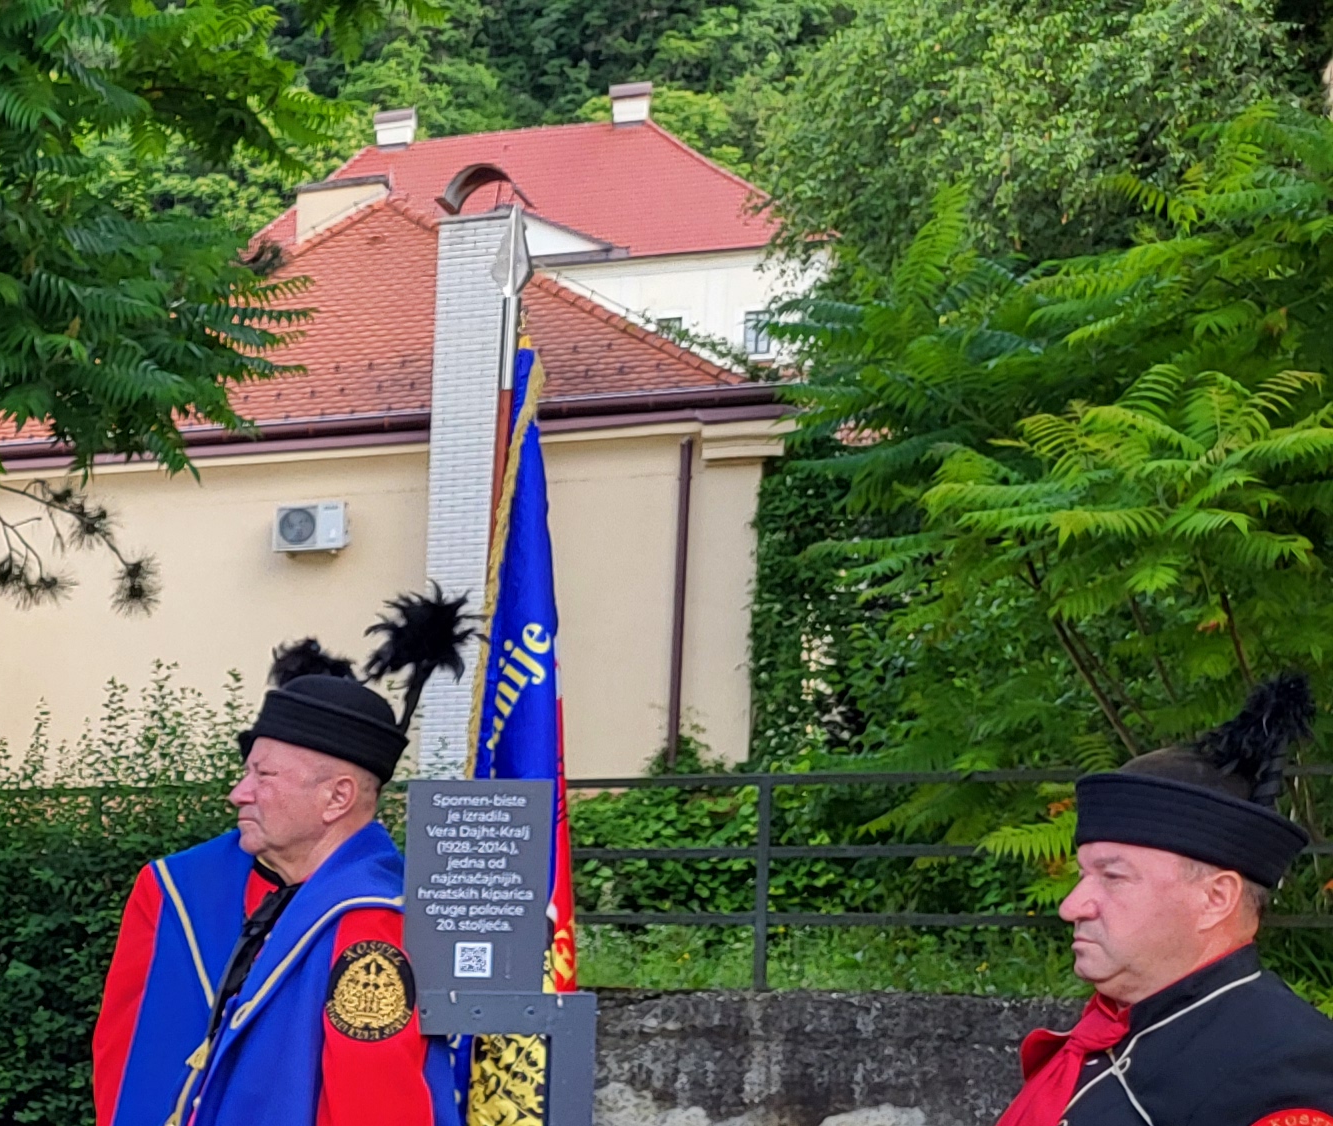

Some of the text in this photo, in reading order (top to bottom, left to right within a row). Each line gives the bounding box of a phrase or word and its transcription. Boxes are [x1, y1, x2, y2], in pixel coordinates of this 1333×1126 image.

[433, 794, 527, 808] Spomen-biste
[446, 810, 510, 823] je izradila
[426, 825, 531, 840] Vera Dajht-Kralj
[446, 857, 506, 870] jedna od
[431, 872, 522, 886] najznačajnijih
[418, 887, 534, 901] hrvatskih kiparica
[426, 903, 524, 917] druge polovice
[436, 919, 512, 933] 20. stoljeća.
